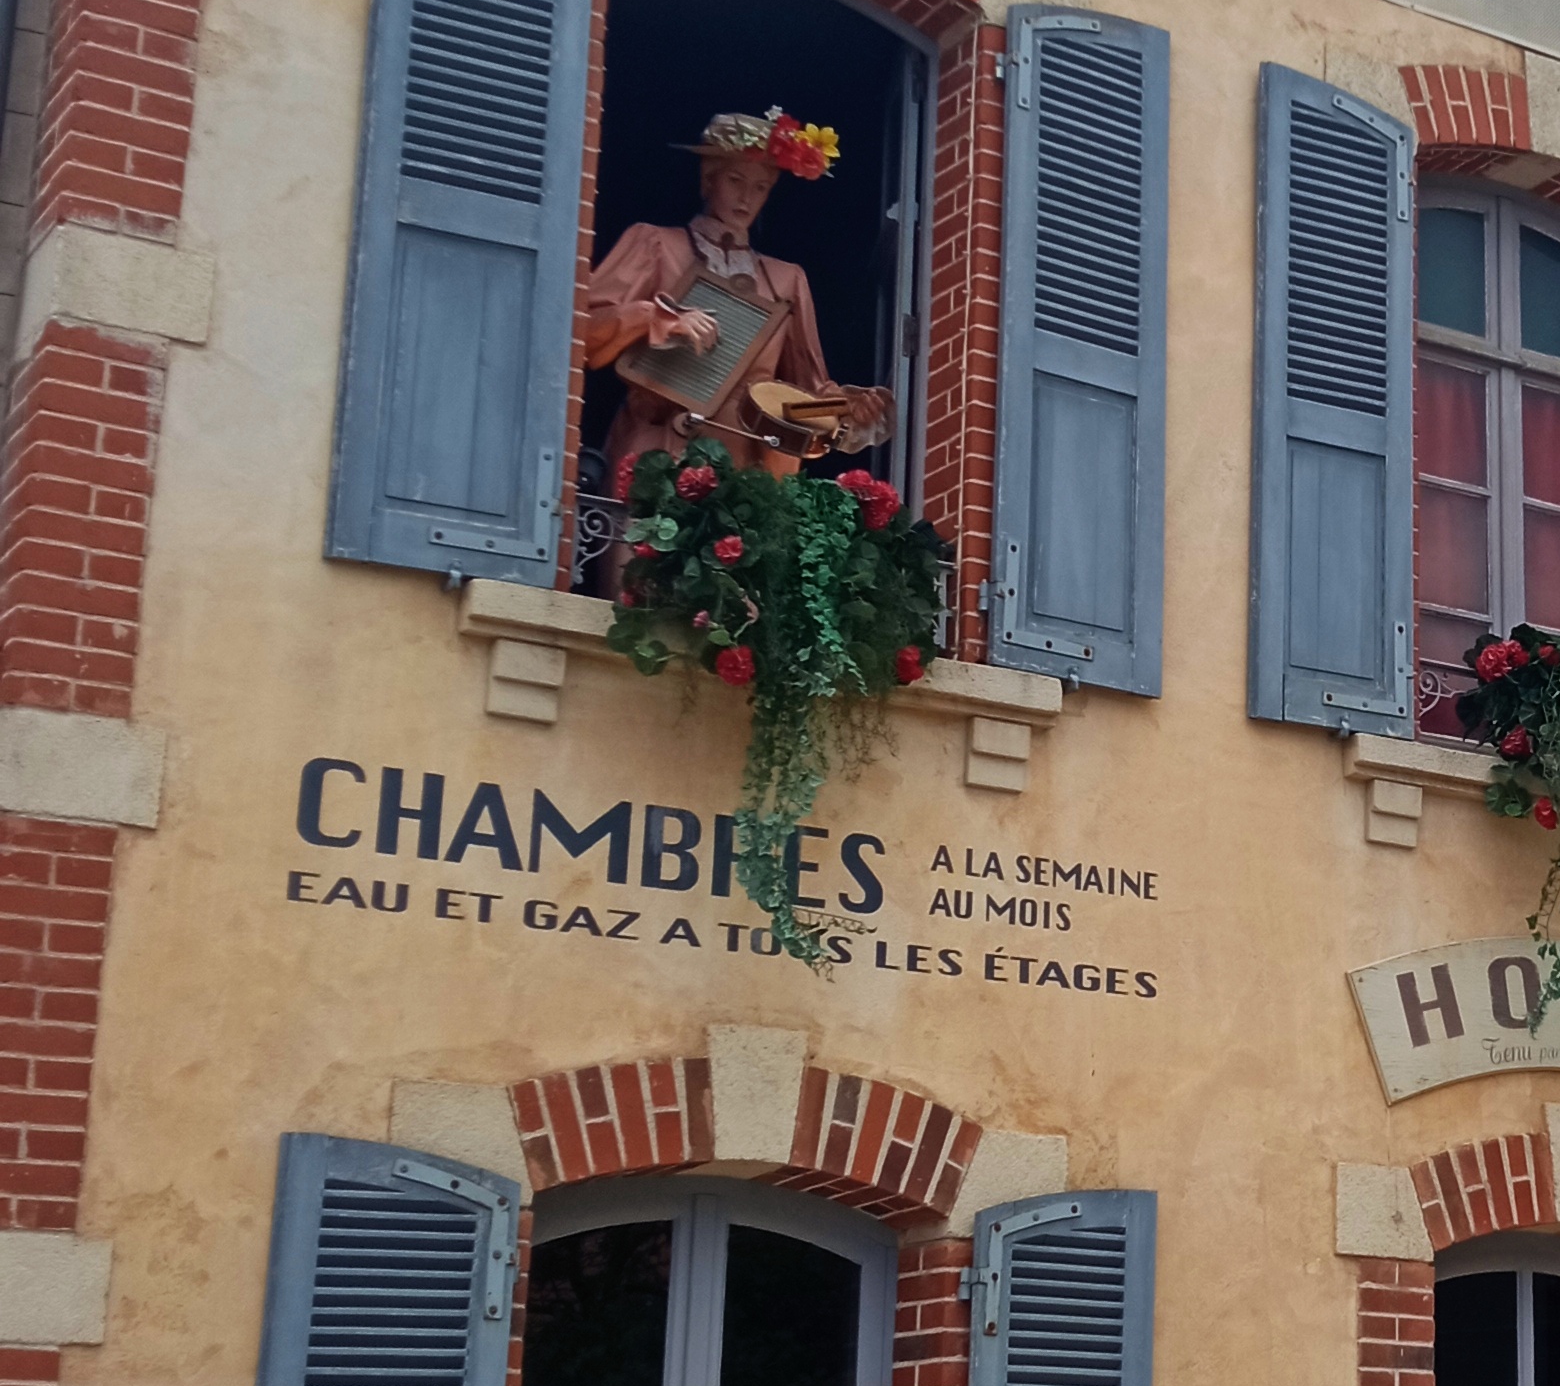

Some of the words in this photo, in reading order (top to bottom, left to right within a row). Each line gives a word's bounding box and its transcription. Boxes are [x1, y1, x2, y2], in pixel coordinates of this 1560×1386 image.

[931, 845, 954, 874] A
[965, 848, 1004, 881] LA
[1015, 855, 1159, 901] SEMAINE
[286, 871, 409, 913] EAU
[435, 888, 503, 923] ET
[523, 900, 641, 941] GAZ
[659, 918, 702, 947] A
[718, 922, 852, 964] TOS
[875, 941, 963, 976] LES
[984, 946, 1158, 998] ÉTAGES
[929, 888, 973, 919] AU
[986, 894, 1071, 931] MOIS
